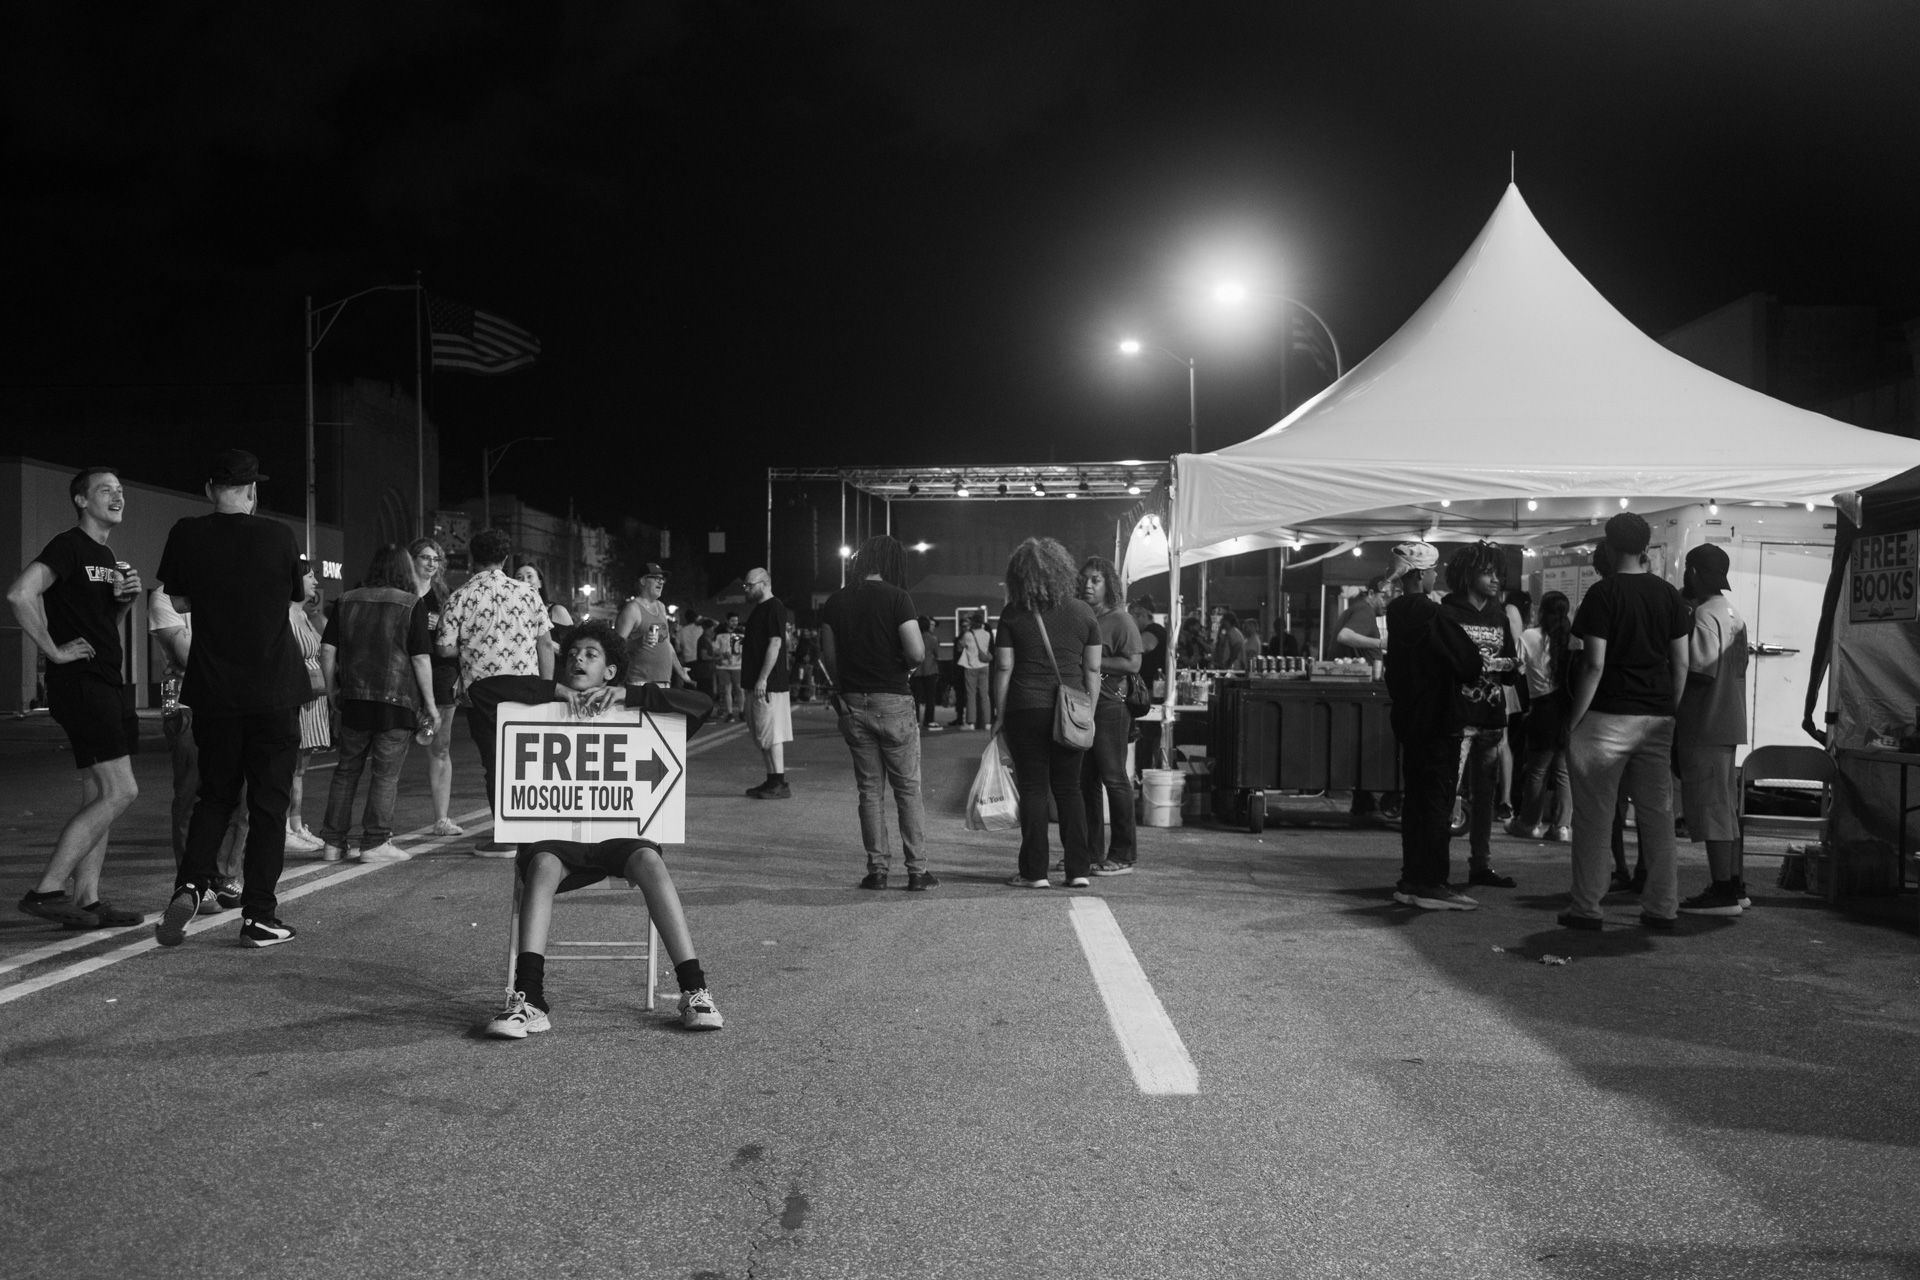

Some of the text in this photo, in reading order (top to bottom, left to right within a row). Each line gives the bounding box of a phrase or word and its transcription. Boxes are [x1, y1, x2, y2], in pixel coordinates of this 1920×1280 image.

[1859, 534, 1908, 569] FREE
[322, 560, 343, 580] BANK
[1853, 571, 1914, 603] BOOKS
[515, 733, 628, 781] FREE
[511, 785, 634, 813] MOSQUE TOUR
[989, 795, 1005, 804] You
